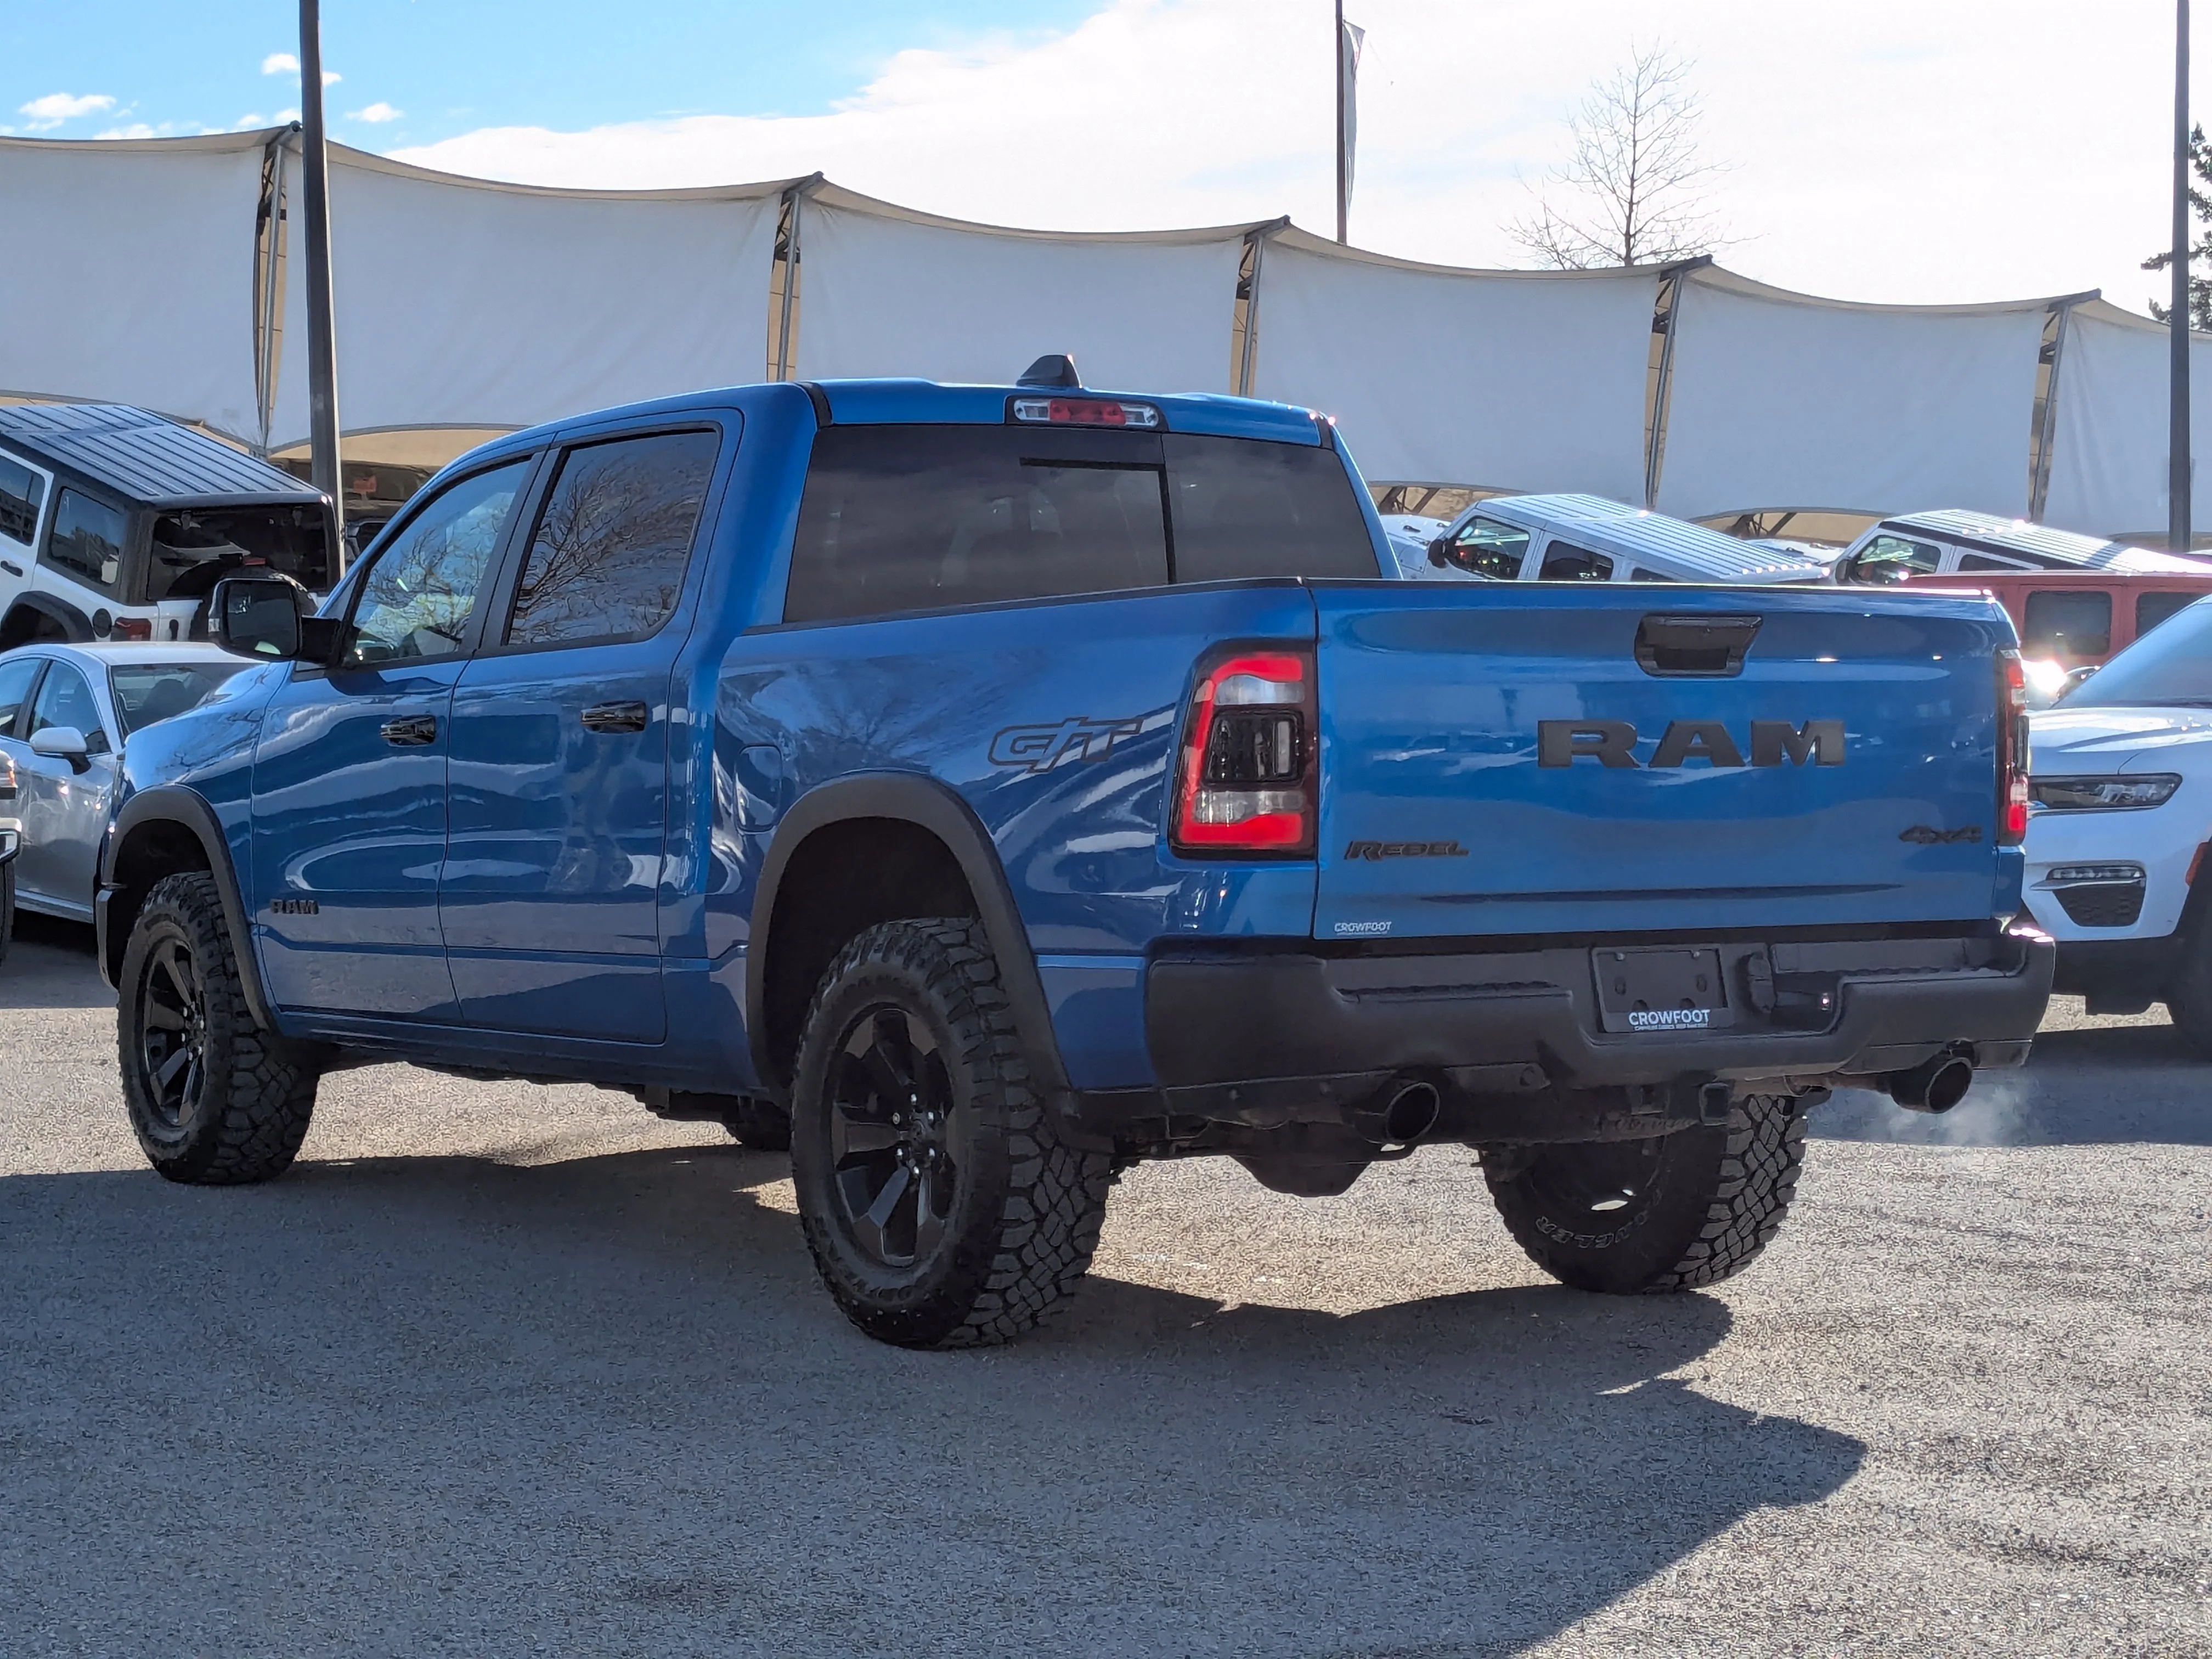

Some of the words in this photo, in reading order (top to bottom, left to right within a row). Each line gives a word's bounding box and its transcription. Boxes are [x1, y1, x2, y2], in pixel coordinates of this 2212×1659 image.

[1538, 719, 1845, 768] RAM
[1344, 840, 1469, 861] REBEL
[269, 899, 319, 915] RAM
[1334, 921, 1392, 933] CROWFOOT
[1629, 1009, 1710, 1025] CROWFOOT
